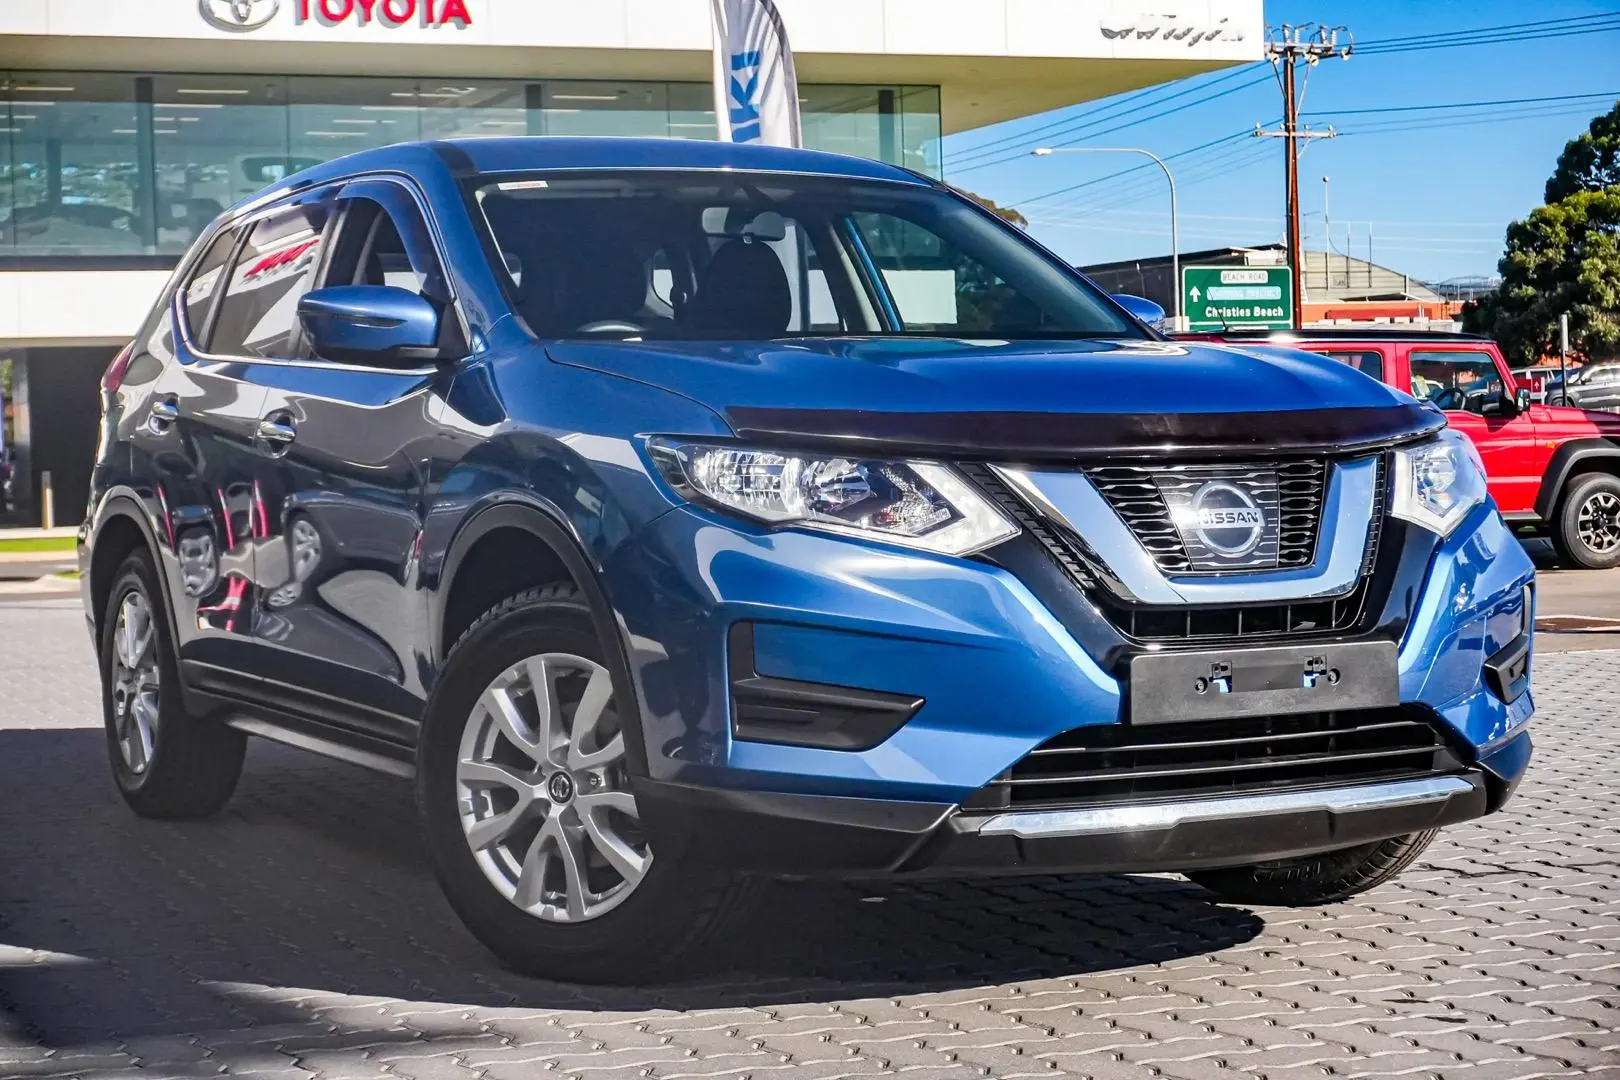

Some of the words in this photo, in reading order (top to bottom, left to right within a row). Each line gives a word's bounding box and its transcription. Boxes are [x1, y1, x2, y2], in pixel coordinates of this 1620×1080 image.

[1223, 272, 1246, 281] BEACH
[1205, 306, 1251, 318] Christies
[1253, 306, 1284, 317] Beach
